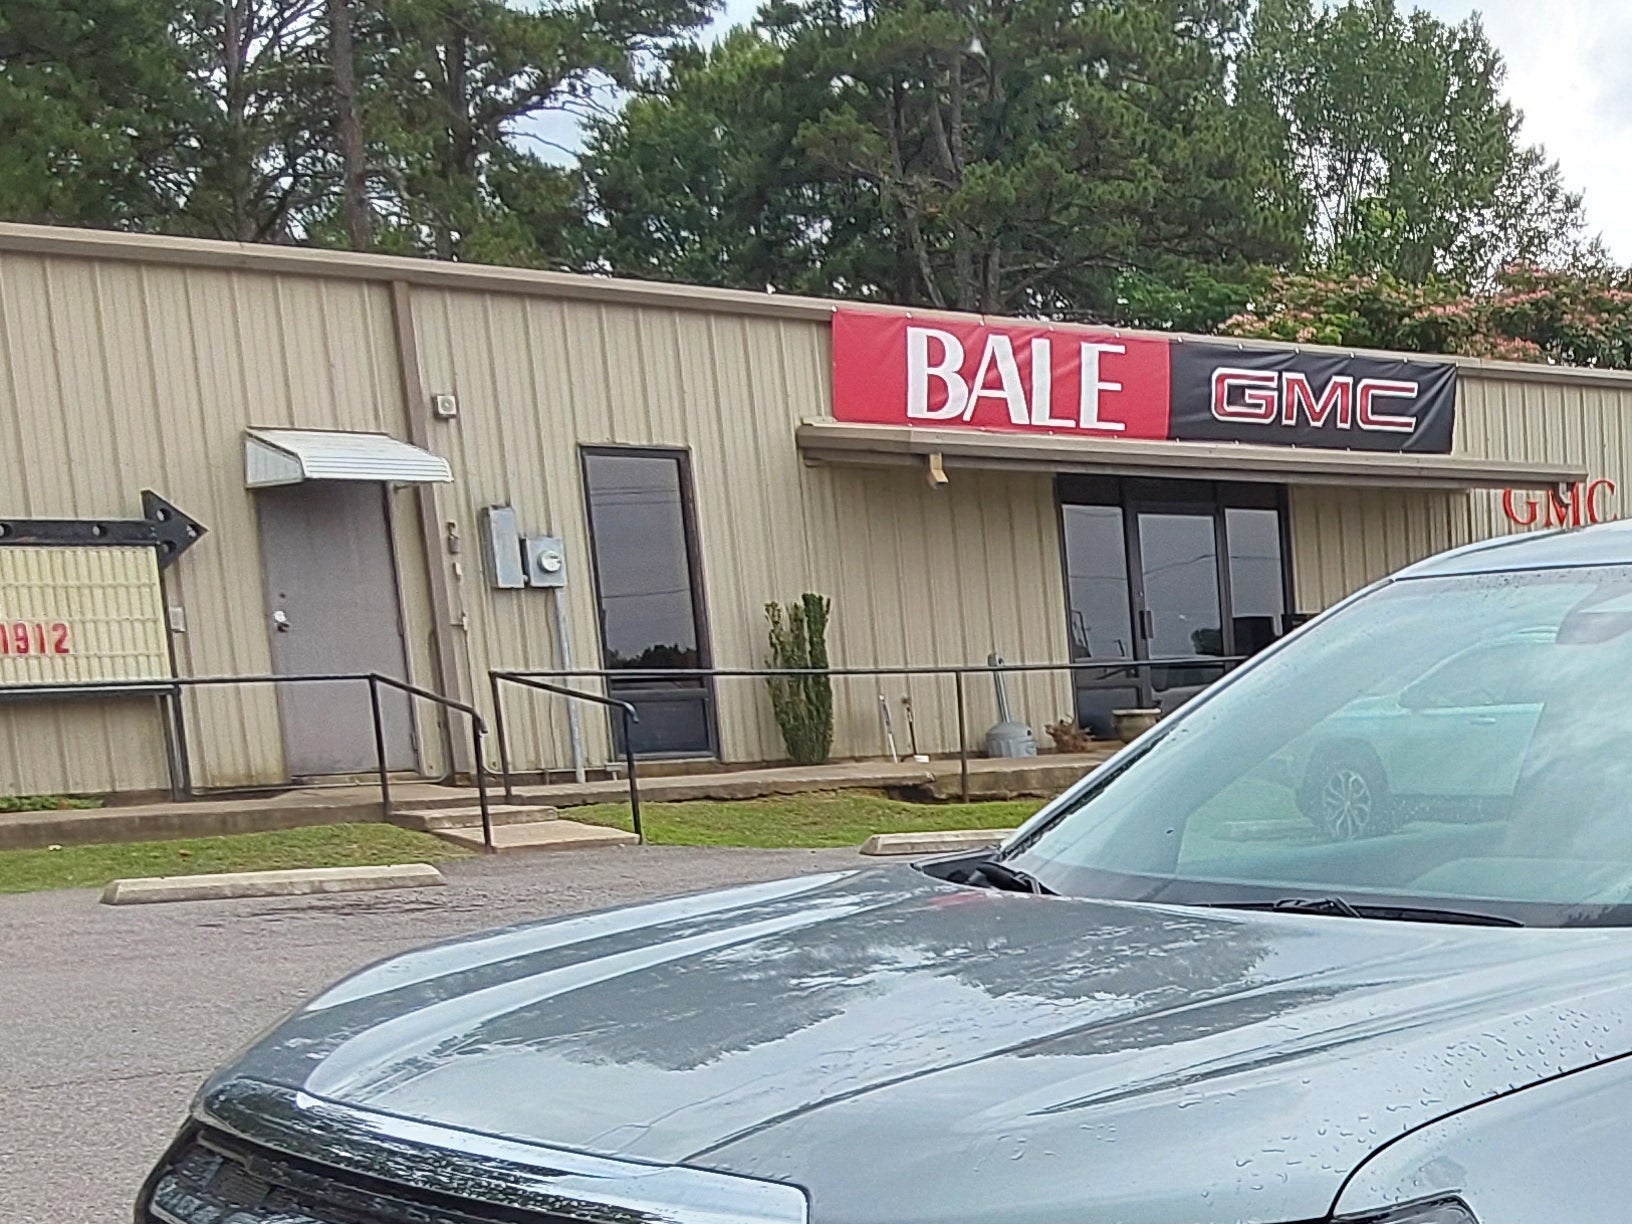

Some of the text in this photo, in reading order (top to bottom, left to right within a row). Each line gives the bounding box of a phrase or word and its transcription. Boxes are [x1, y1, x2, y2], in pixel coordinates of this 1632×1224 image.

[906, 325, 1418, 433] BALE GMC
[1502, 479, 1618, 528] GMC
